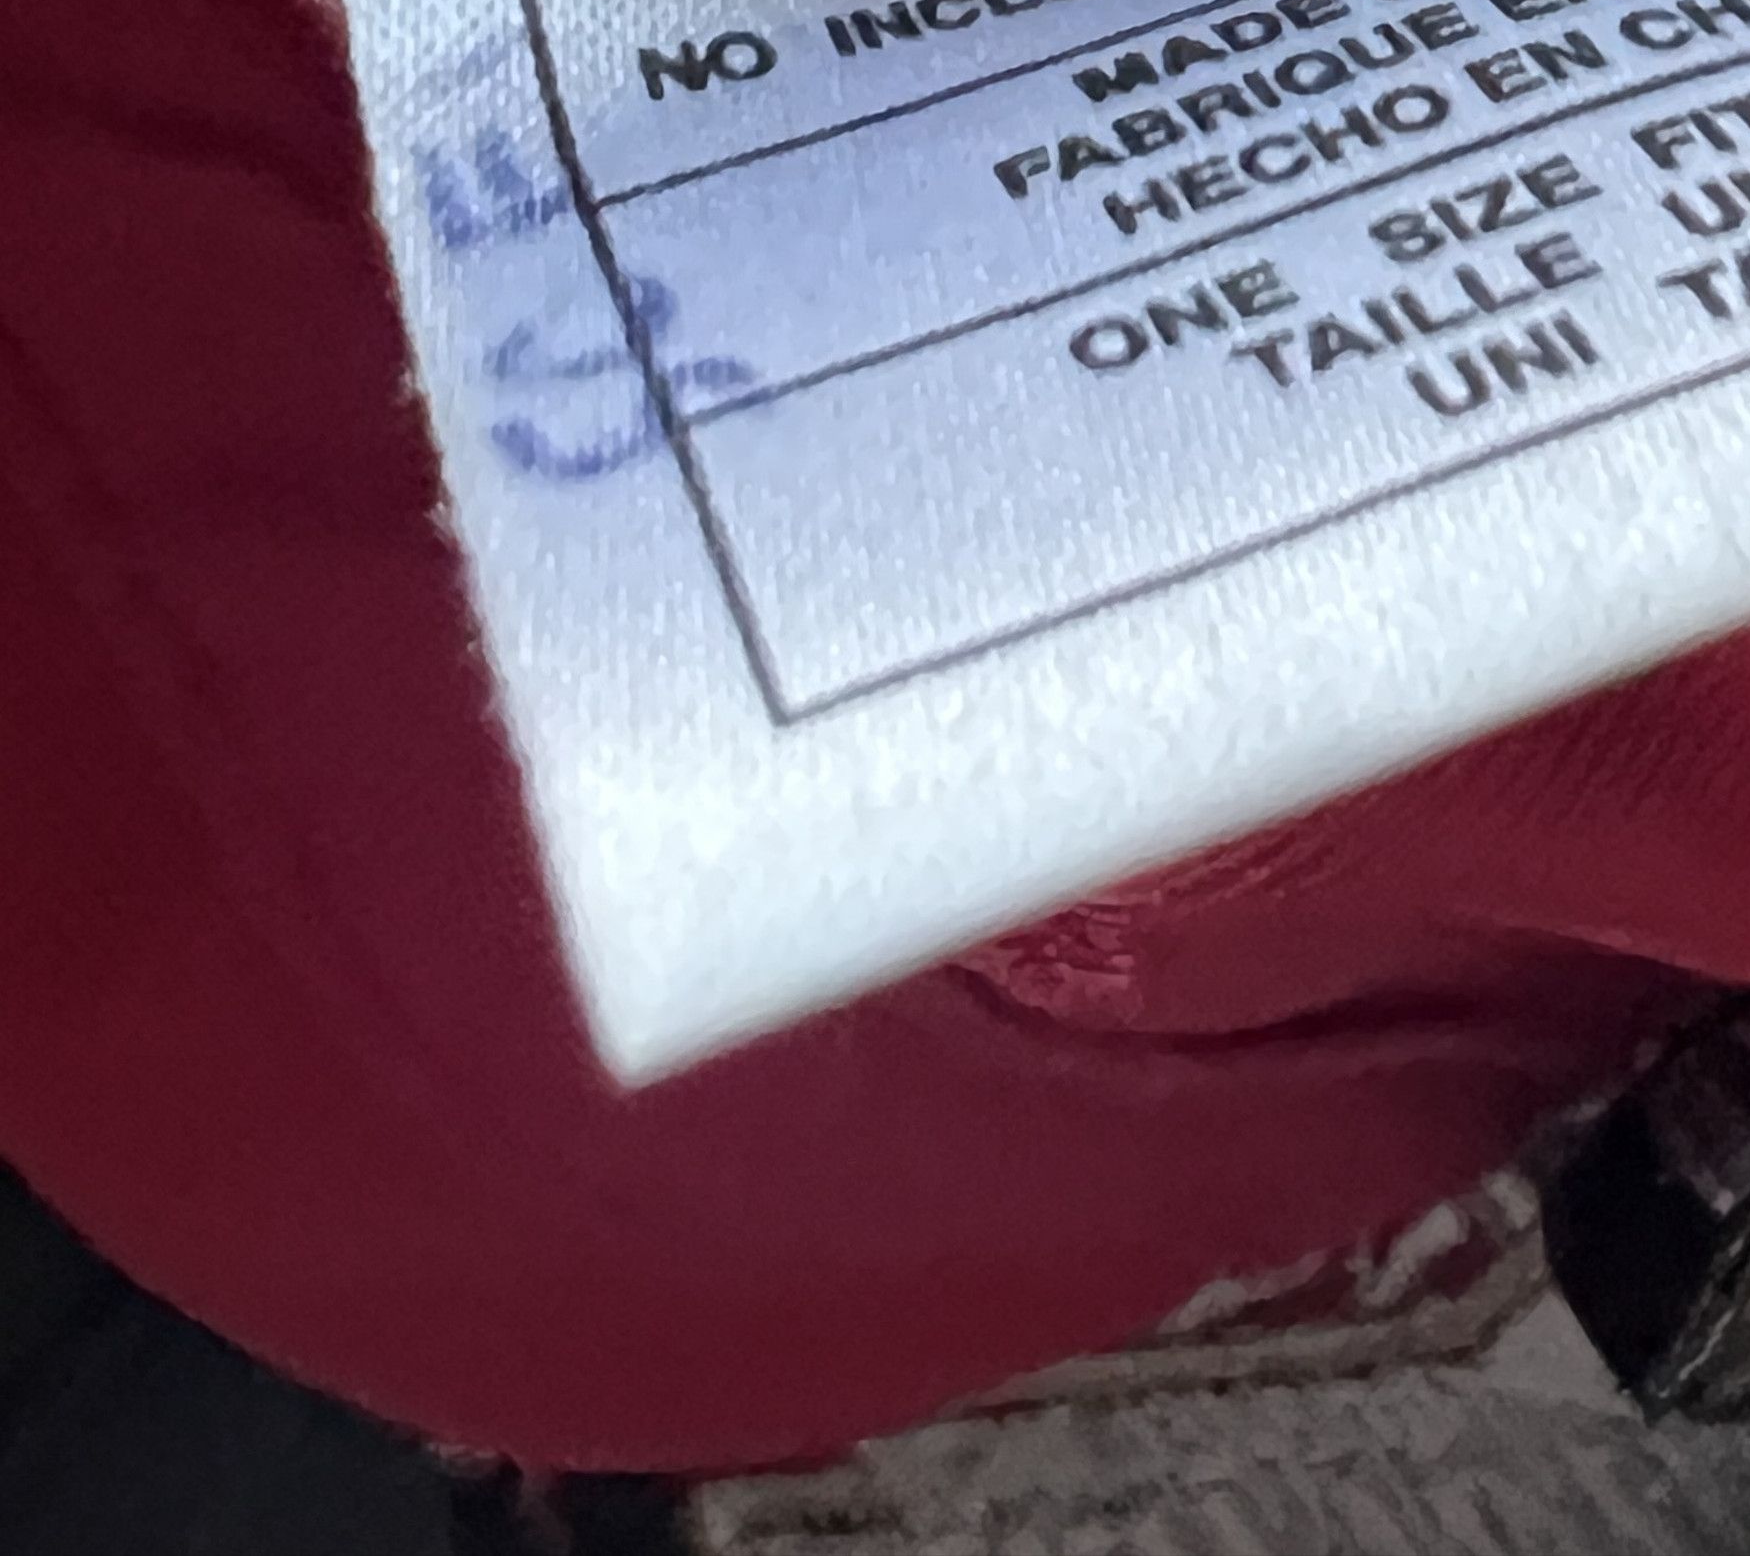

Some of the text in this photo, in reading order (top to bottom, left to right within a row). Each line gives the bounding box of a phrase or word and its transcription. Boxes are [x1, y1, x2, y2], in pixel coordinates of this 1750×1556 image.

[637, 30, 777, 101] NO
[993, 1, 1480, 198] FABRIQUE
[1103, 84, 1451, 235] HECHO
[1463, 28, 1608, 103] EN
[1069, 258, 1301, 370] ONE
[1367, 152, 1604, 263] SIZE
[1229, 229, 1604, 388] TAILLE
[1406, 310, 1602, 417] UNI
